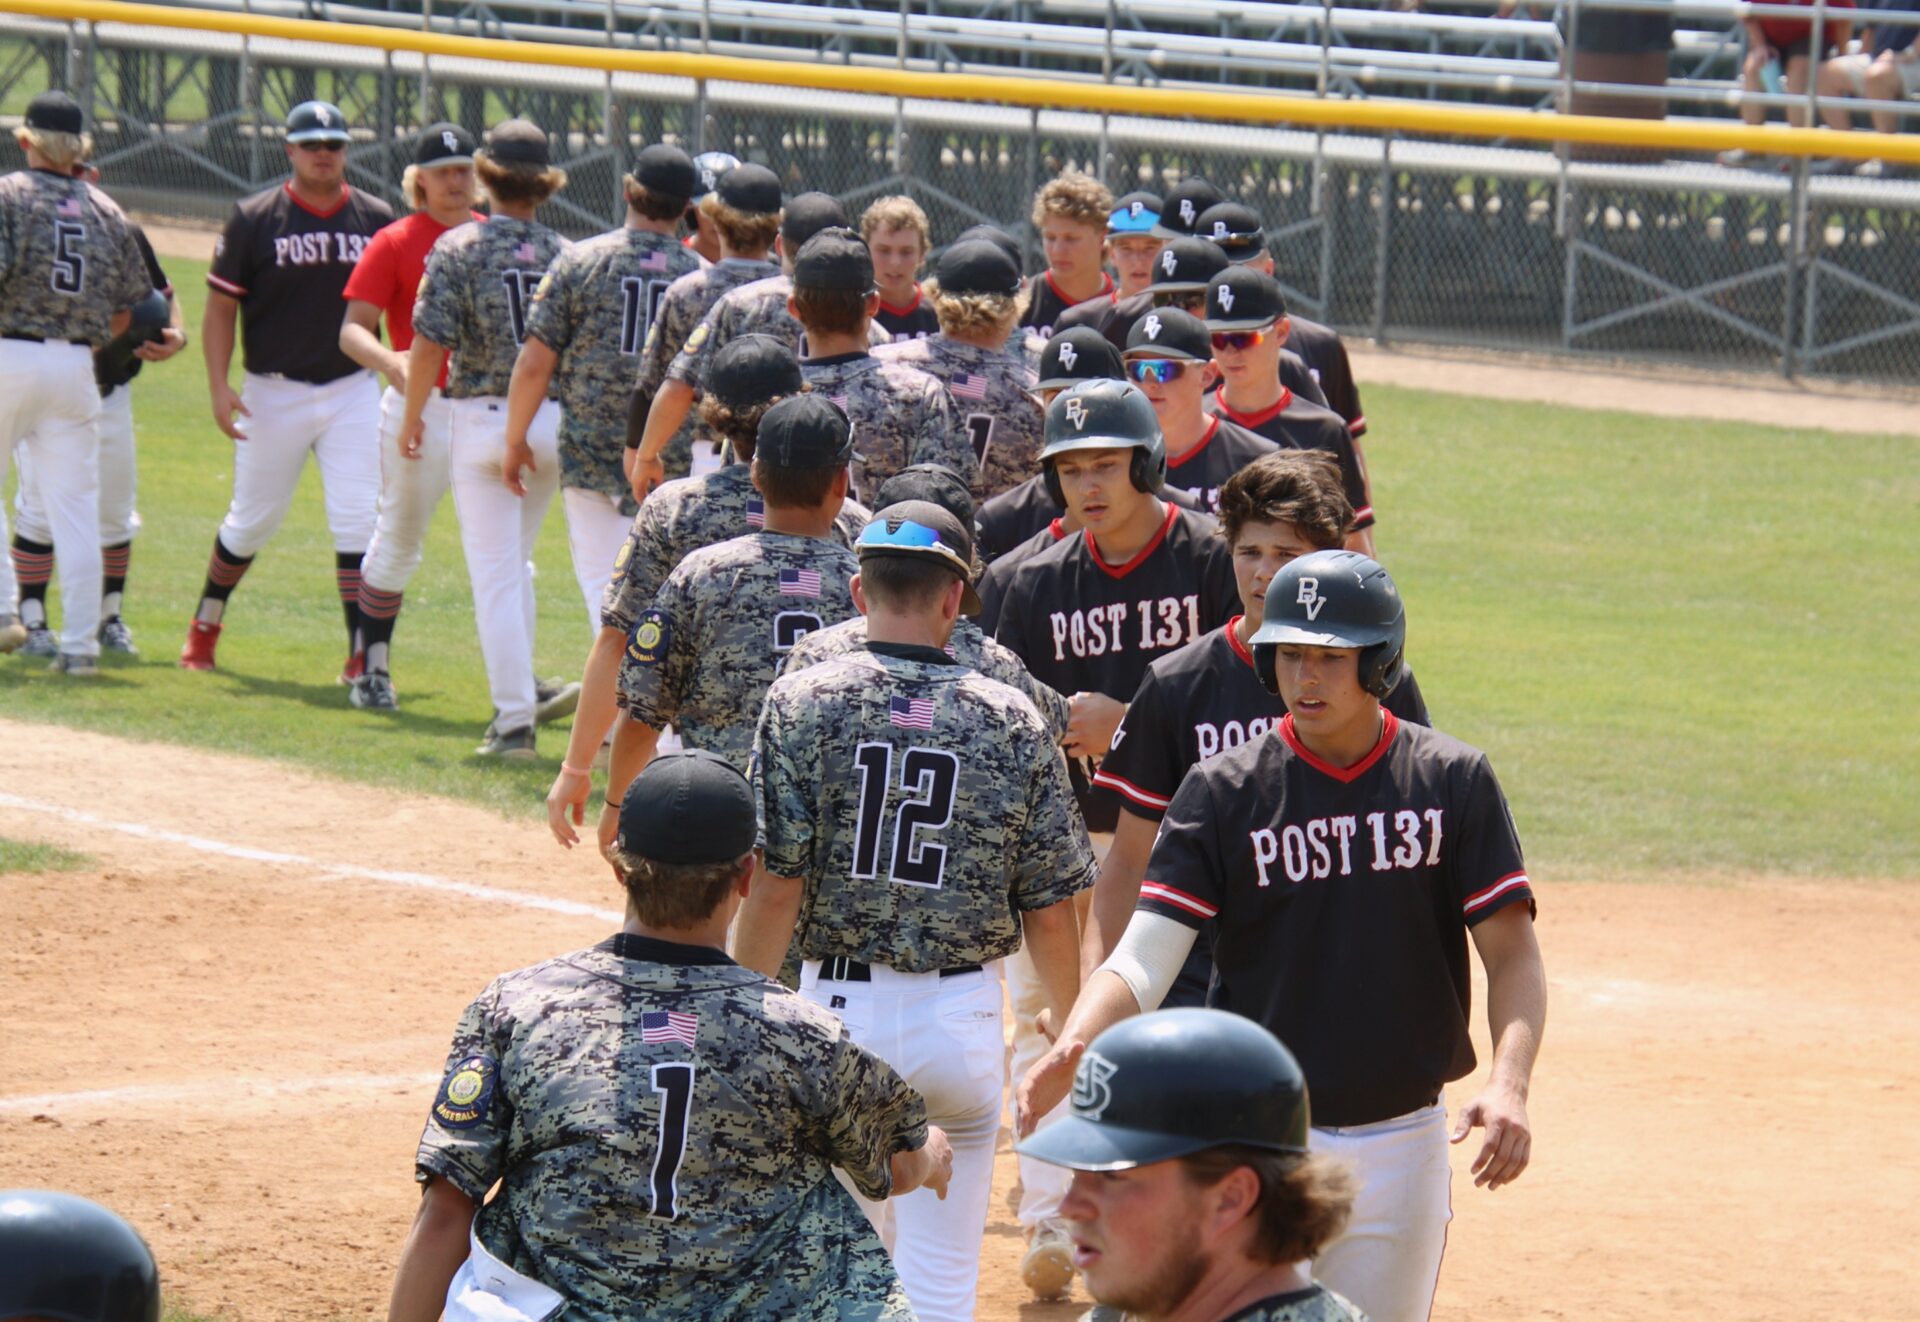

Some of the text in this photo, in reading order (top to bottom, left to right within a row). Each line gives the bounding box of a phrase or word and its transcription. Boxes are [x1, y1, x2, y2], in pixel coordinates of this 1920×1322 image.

[52, 221, 85, 294] 5
[274, 231, 331, 266] POST
[1050, 594, 1200, 661] POST 131
[1296, 577, 1327, 621] BV
[852, 743, 960, 890] 12
[1250, 808, 1444, 888] POST 131
[650, 1061, 696, 1222] 1
